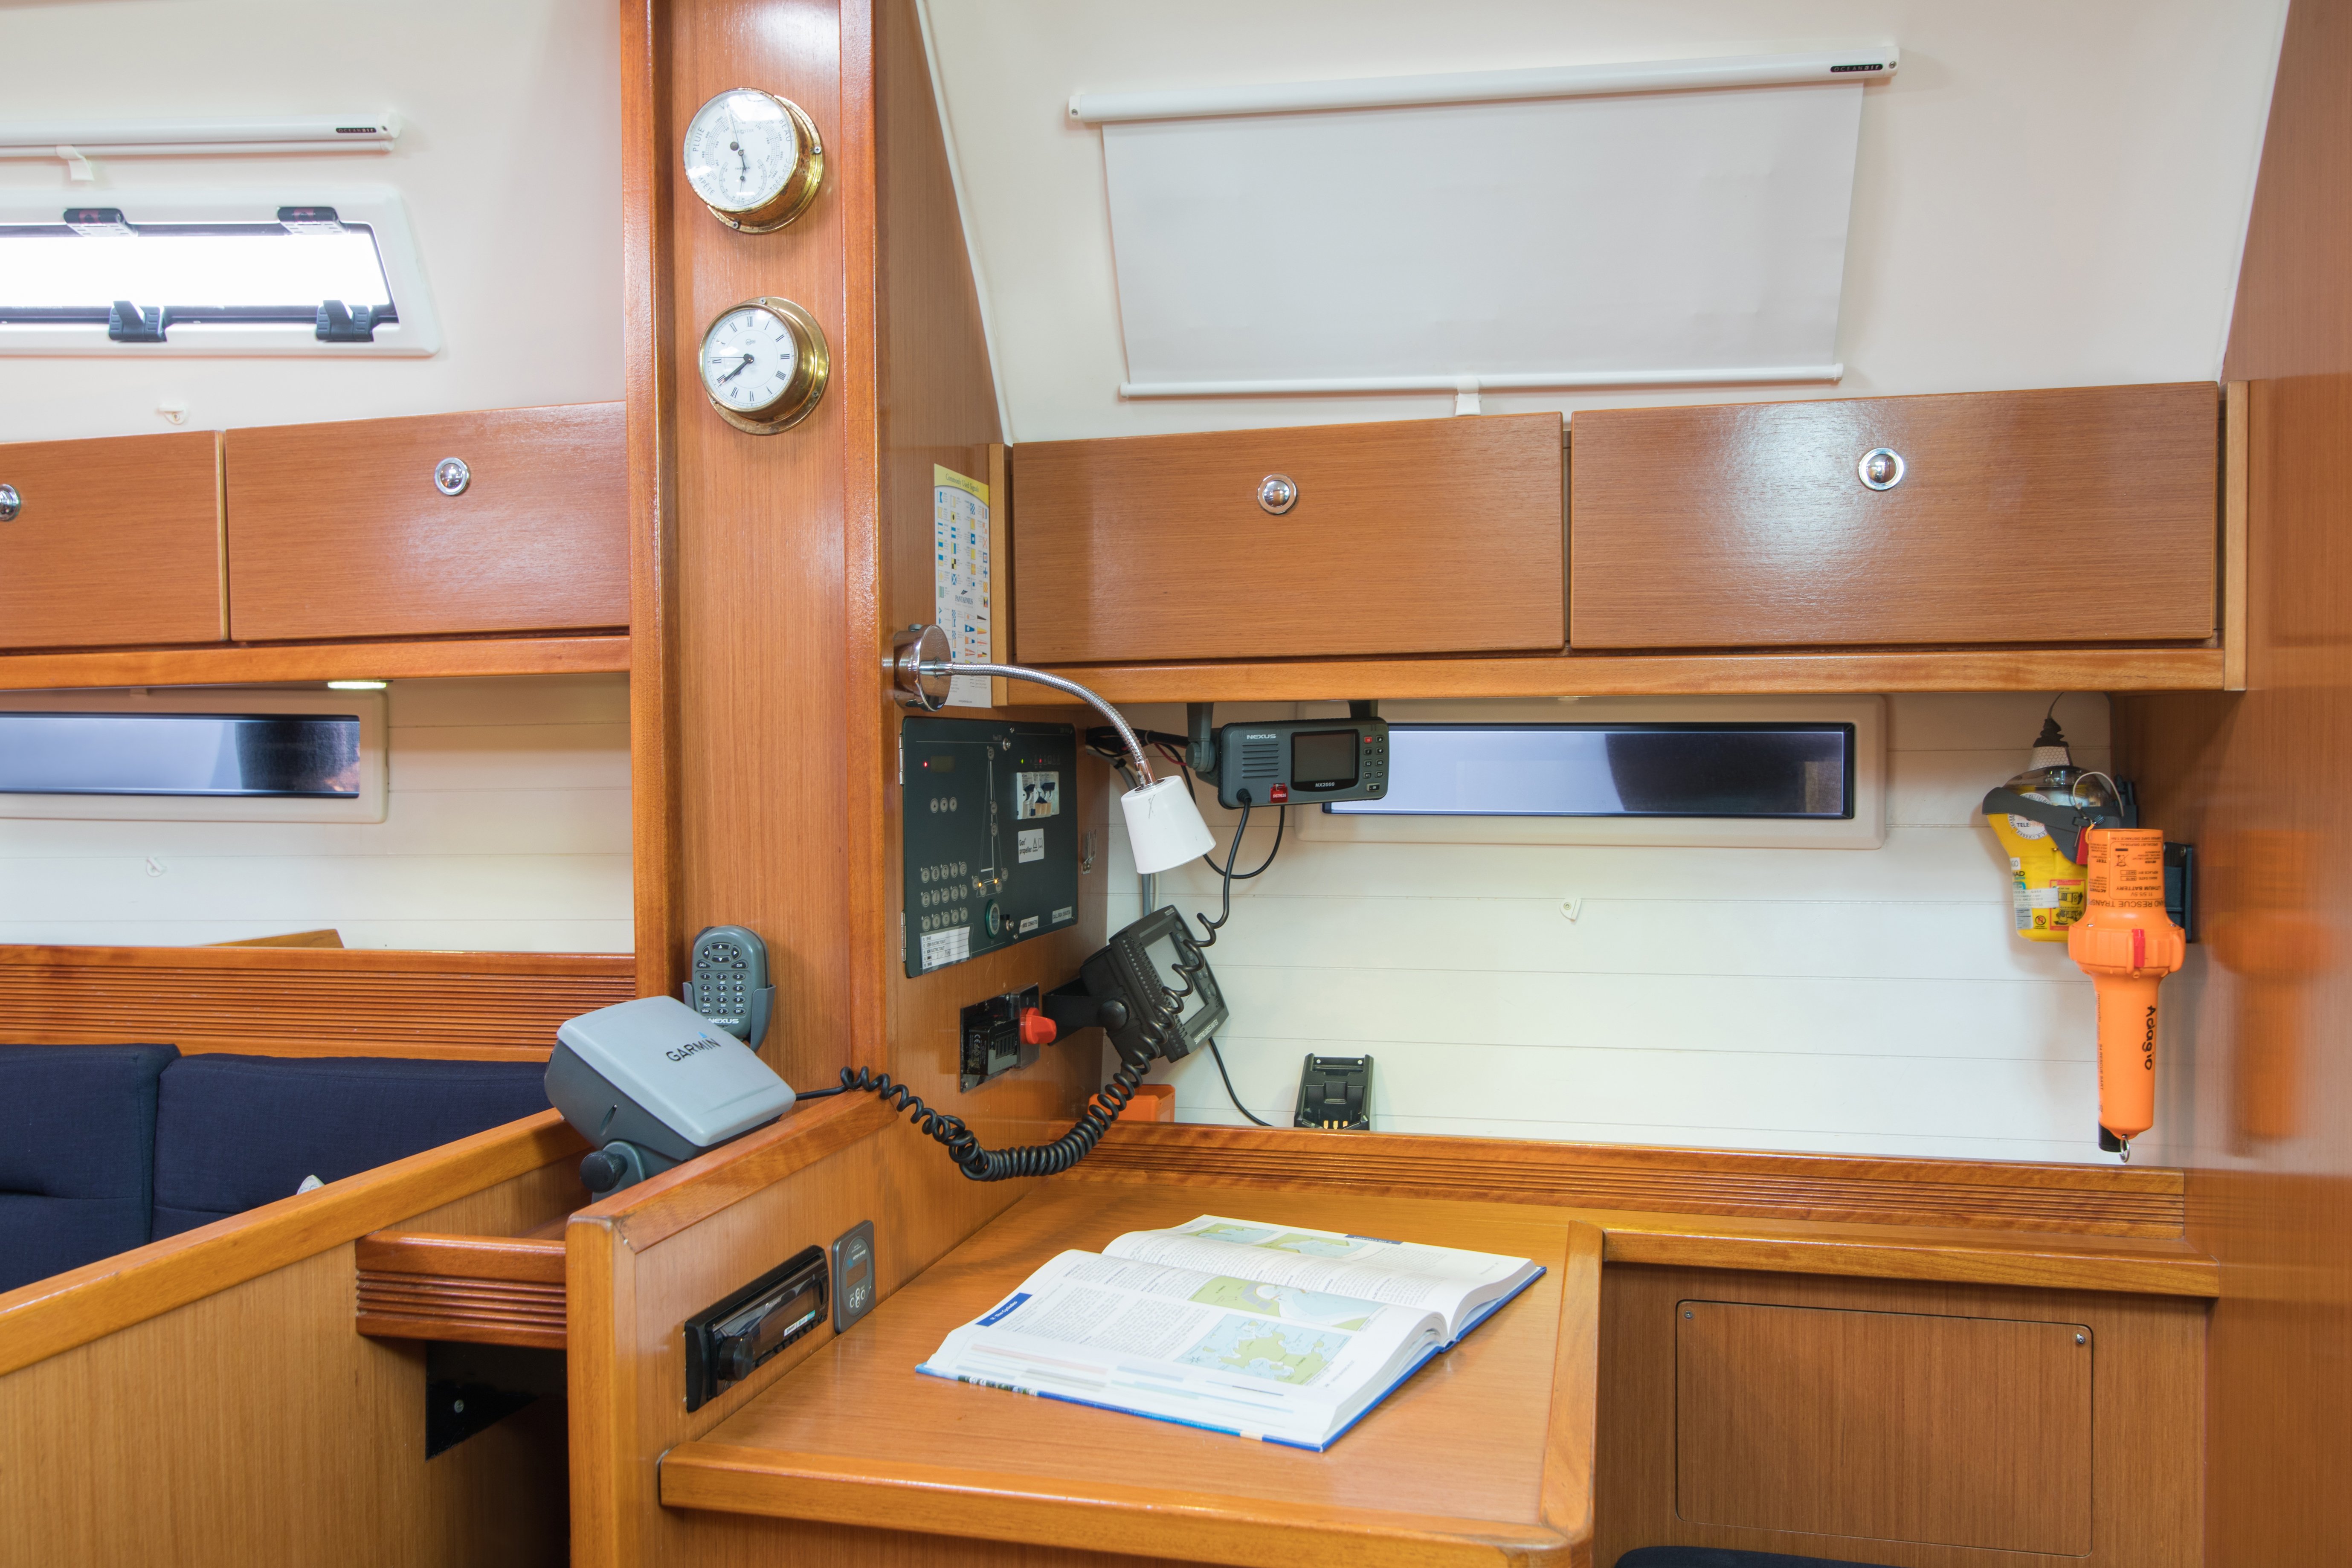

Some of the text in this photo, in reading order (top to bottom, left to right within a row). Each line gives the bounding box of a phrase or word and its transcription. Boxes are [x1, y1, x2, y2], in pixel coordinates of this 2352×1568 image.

[693, 127, 705, 152] PLUIE
[945, 473, 961, 487] Commonly
[970, 483, 979, 493] Signals
[955, 595, 974, 605] PANTAENIUS
[2141, 1005, 2156, 1070] Adagio
[666, 1038, 721, 1062] GARMIN
[766, 1296, 781, 1310] Pioneer
